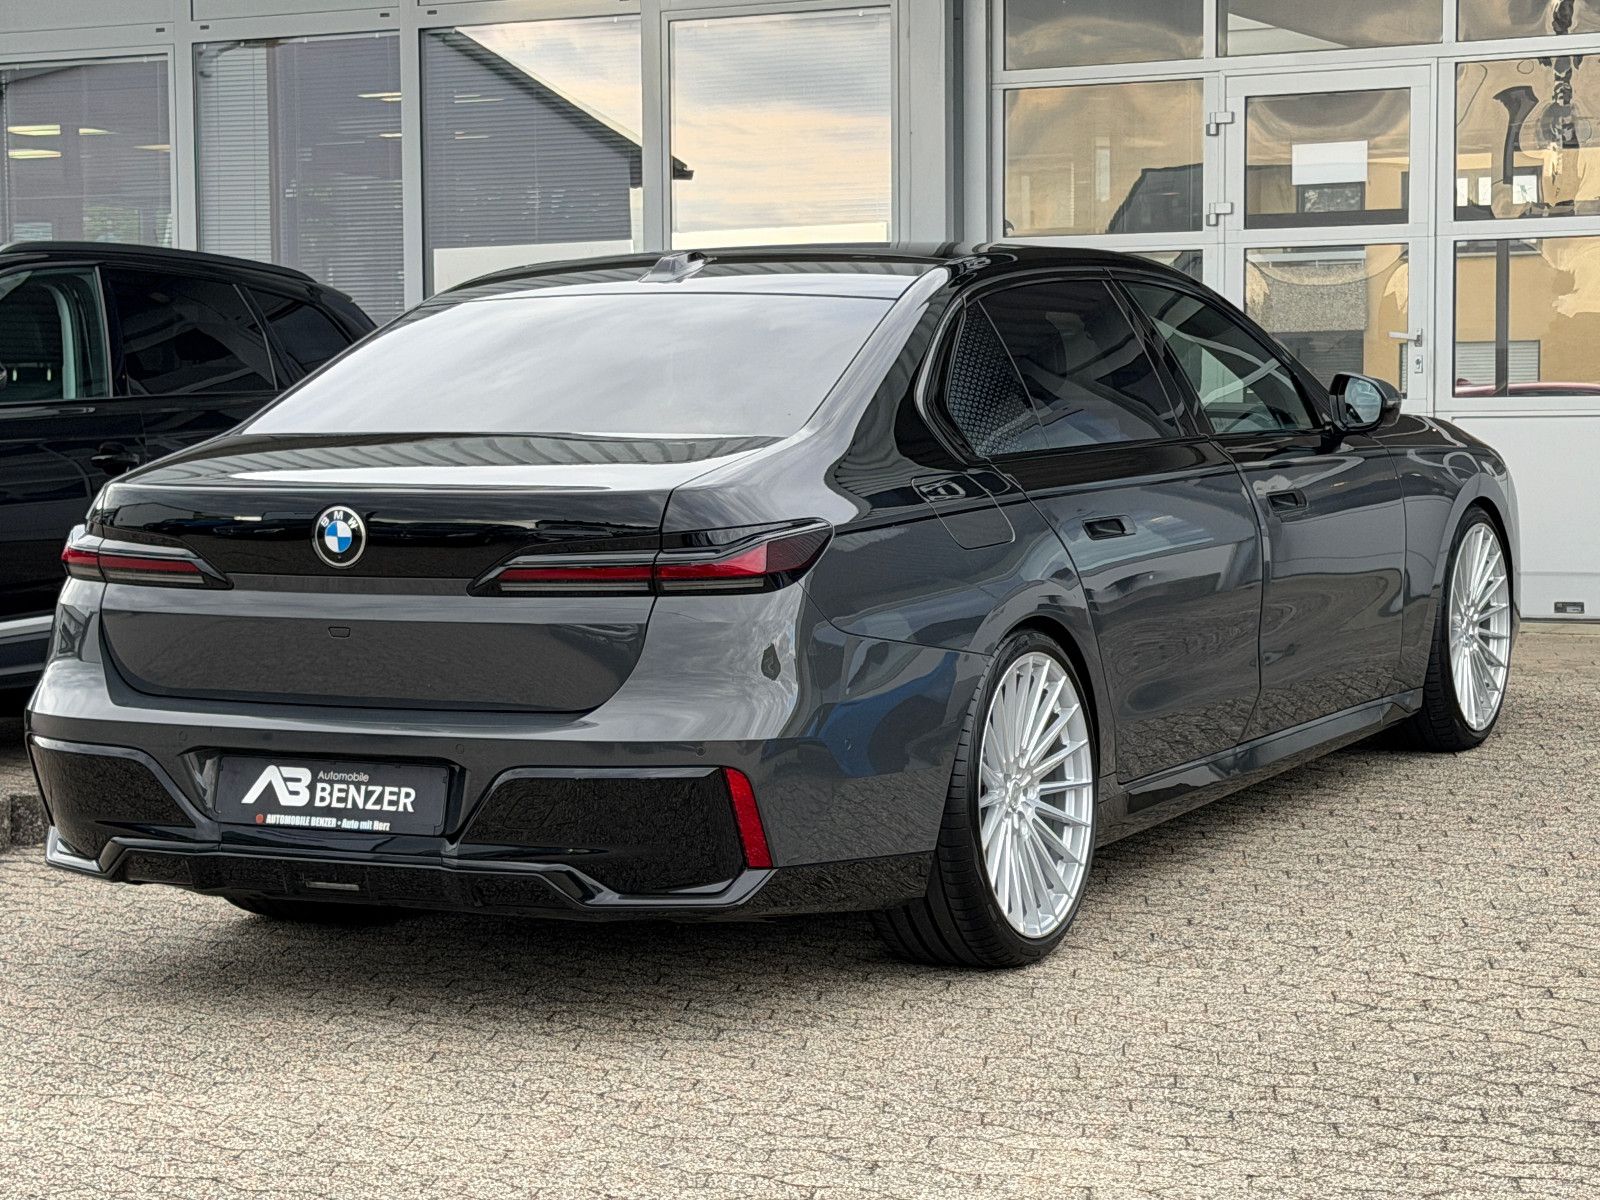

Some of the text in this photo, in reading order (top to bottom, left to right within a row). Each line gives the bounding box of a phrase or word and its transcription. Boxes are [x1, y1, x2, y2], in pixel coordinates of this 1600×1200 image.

[320, 510, 359, 529] BMW
[317, 770, 370, 783] Automobile
[314, 782, 416, 813] BENZER
[265, 814, 391, 831] AUTOMOBILE BENZER Auto mit Herz
